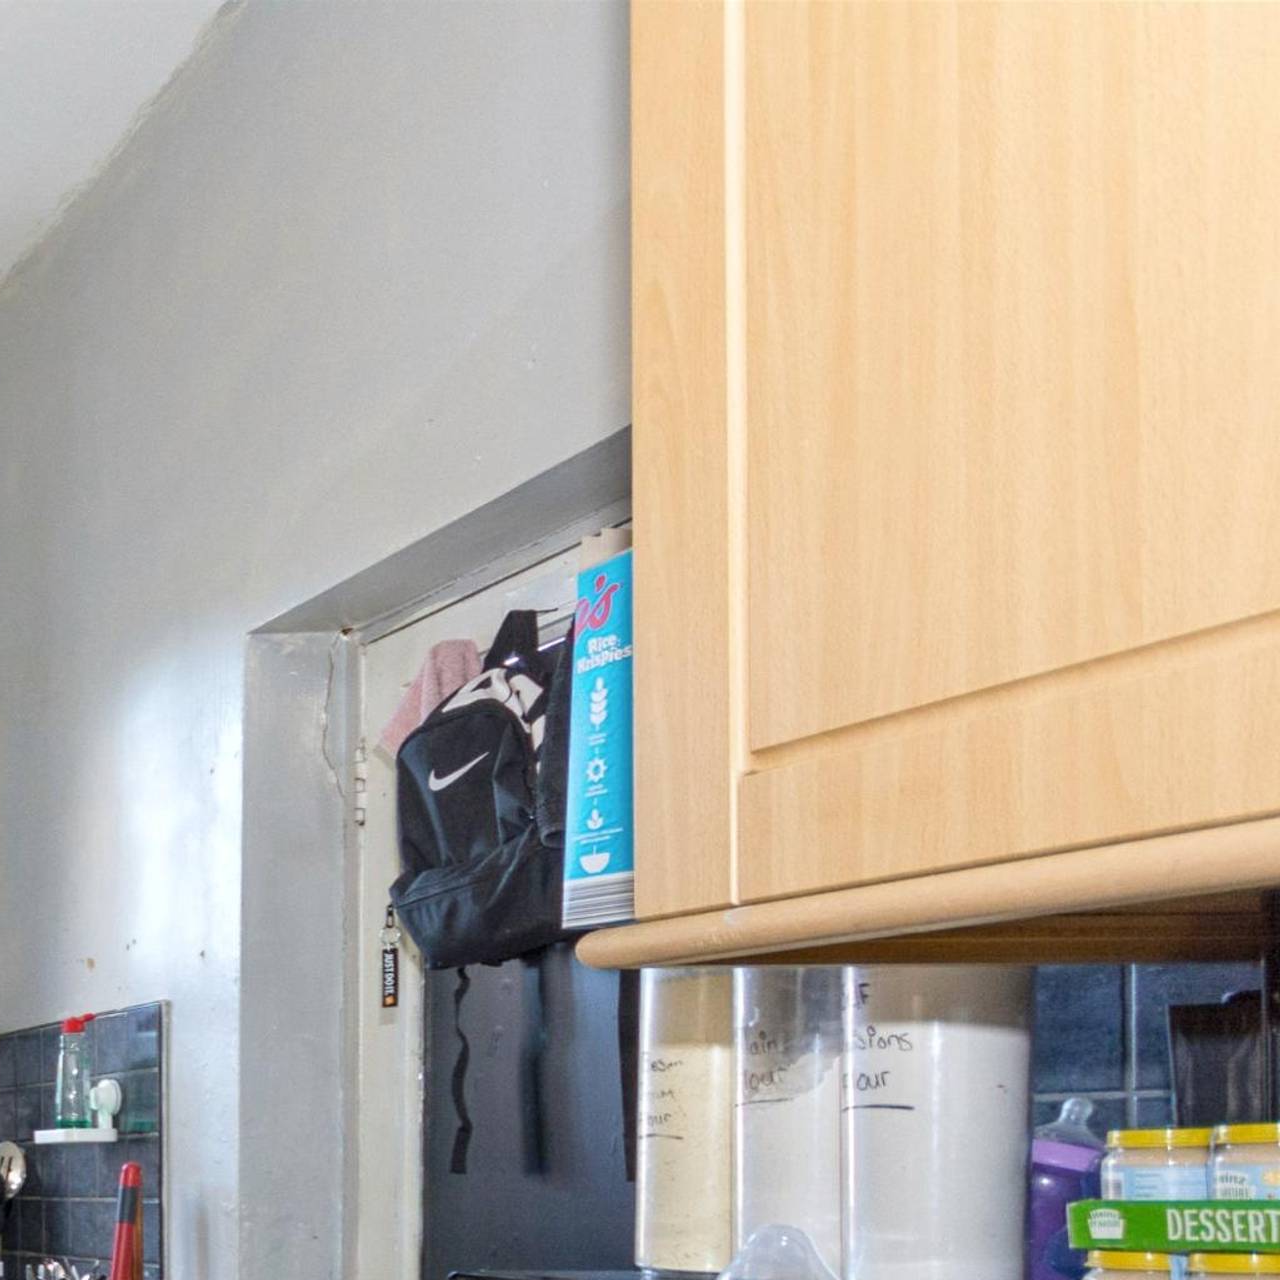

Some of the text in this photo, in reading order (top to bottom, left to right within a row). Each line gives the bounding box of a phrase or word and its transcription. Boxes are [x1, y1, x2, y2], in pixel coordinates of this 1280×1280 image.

[587, 634, 618, 655] Rice
[383, 952, 395, 971] JUST
[1166, 1207, 1280, 1244] DESSERT
